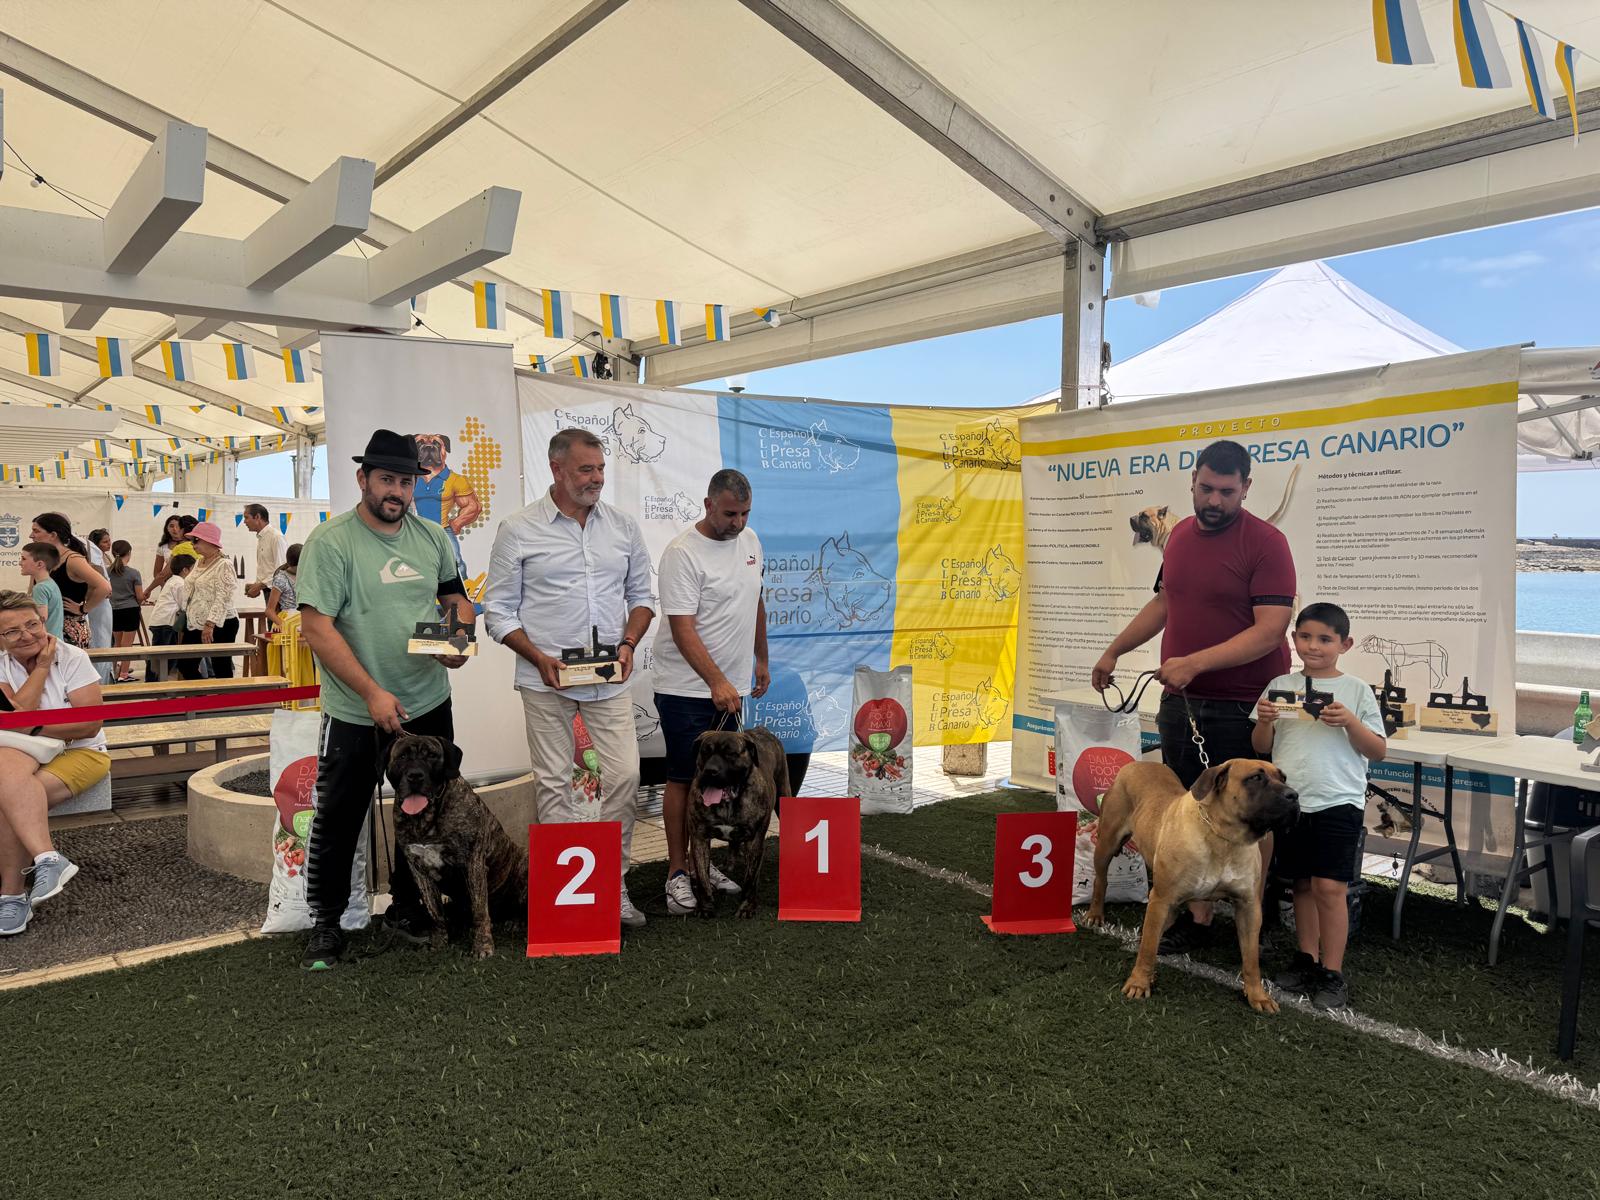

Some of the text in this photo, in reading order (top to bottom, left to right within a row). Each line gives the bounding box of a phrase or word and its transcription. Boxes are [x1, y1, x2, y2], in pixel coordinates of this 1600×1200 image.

[565, 412, 610, 426] Español
[1180, 418, 1280, 438] PROYECTO
[770, 429, 810, 440] Español
[949, 432, 984, 442] Español
[770, 444, 810, 458] Presa
[952, 446, 984, 458] Presa
[1130, 453, 1170, 474] ERA
[1248, 439, 1310, 464] RESA
[772, 458, 812, 470] Canario
[953, 456, 986, 468] Canario
[952, 558, 984, 570] Español
[950, 574, 982, 586] Presa
[766, 586, 812, 603] resa
[949, 588, 981, 599] Canario
[766, 606, 812, 625] nario
[942, 690, 973, 703] Español
[766, 700, 805, 712] Español
[940, 706, 972, 718] Presa
[764, 716, 801, 728] Presa
[938, 717, 970, 730] Canario
[1384, 768, 1414, 778] función
[805, 820, 829, 873] 1
[1018, 834, 1054, 888] 3
[554, 846, 596, 906] 2
